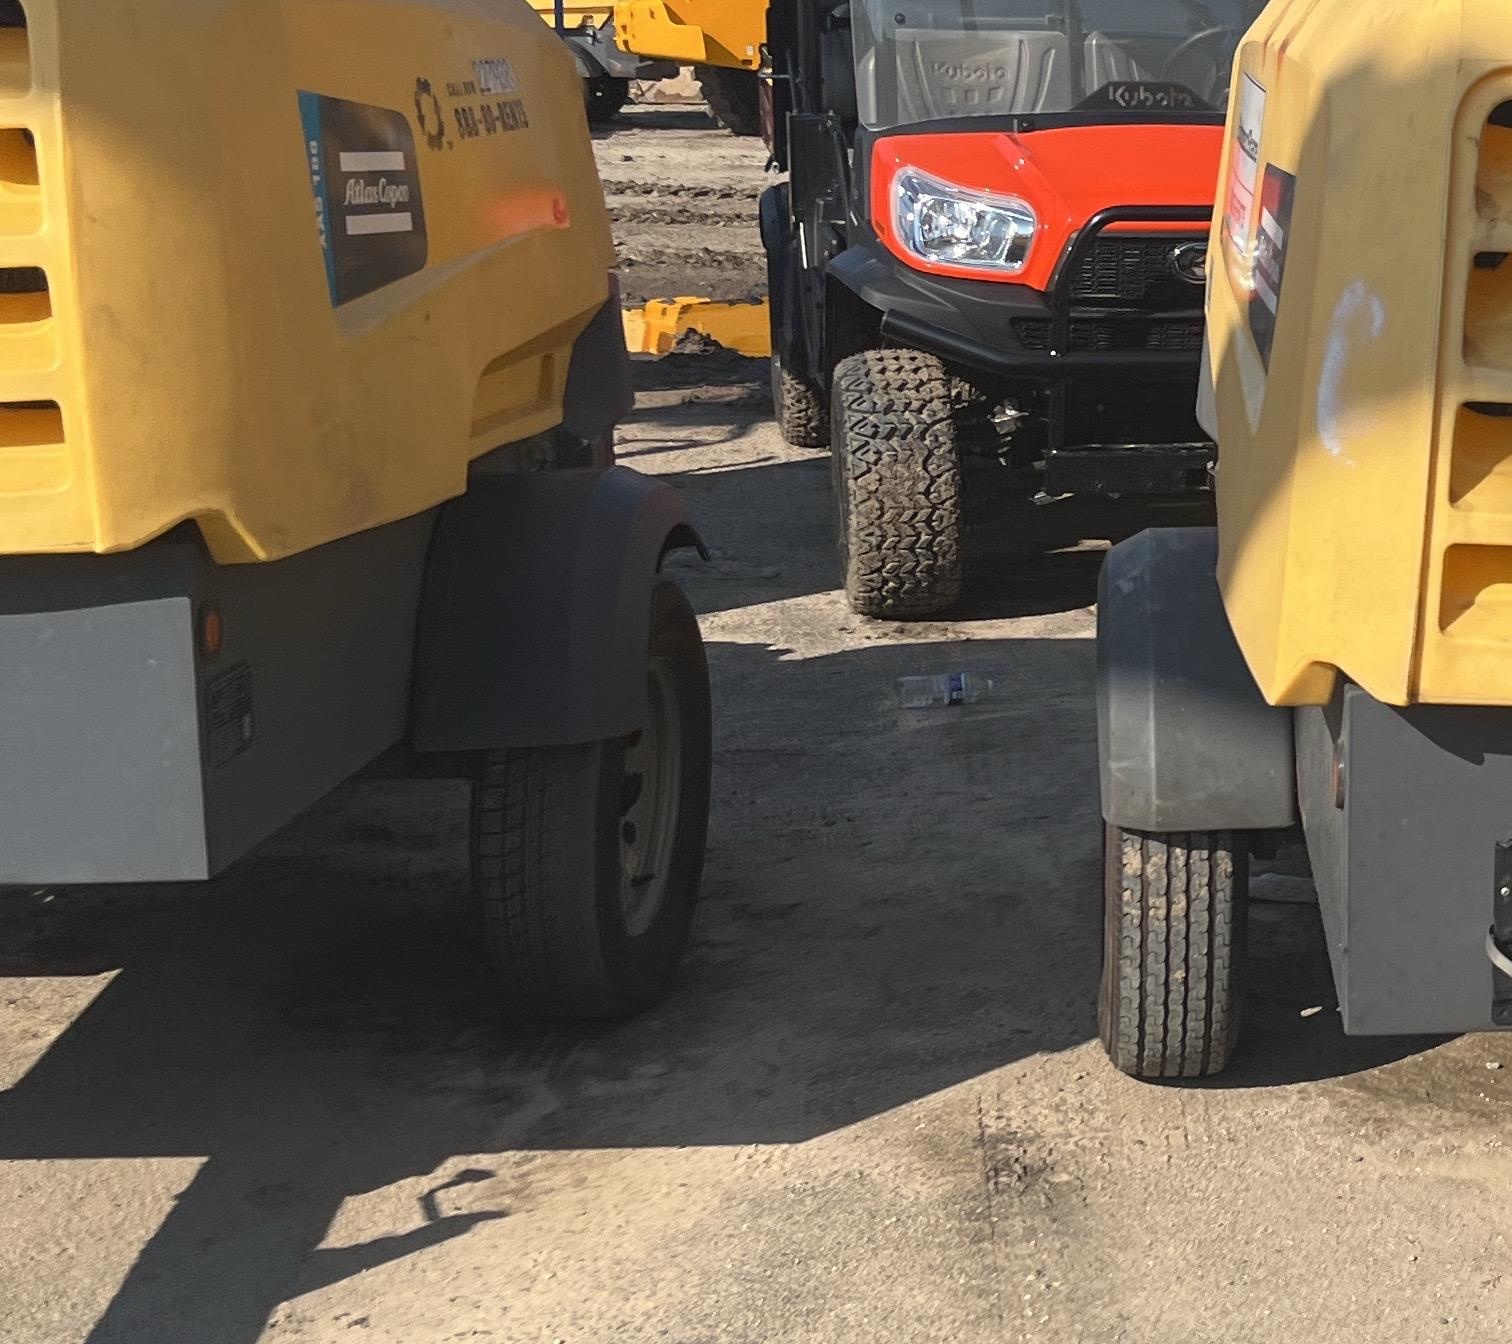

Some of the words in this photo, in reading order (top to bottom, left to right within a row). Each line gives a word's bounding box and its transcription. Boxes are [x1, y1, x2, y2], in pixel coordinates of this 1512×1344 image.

[931, 59, 1010, 82] Kubota
[1107, 85, 1194, 108] Kubota
[343, 177, 379, 206] Atlas
[378, 176, 410, 208] Copco
